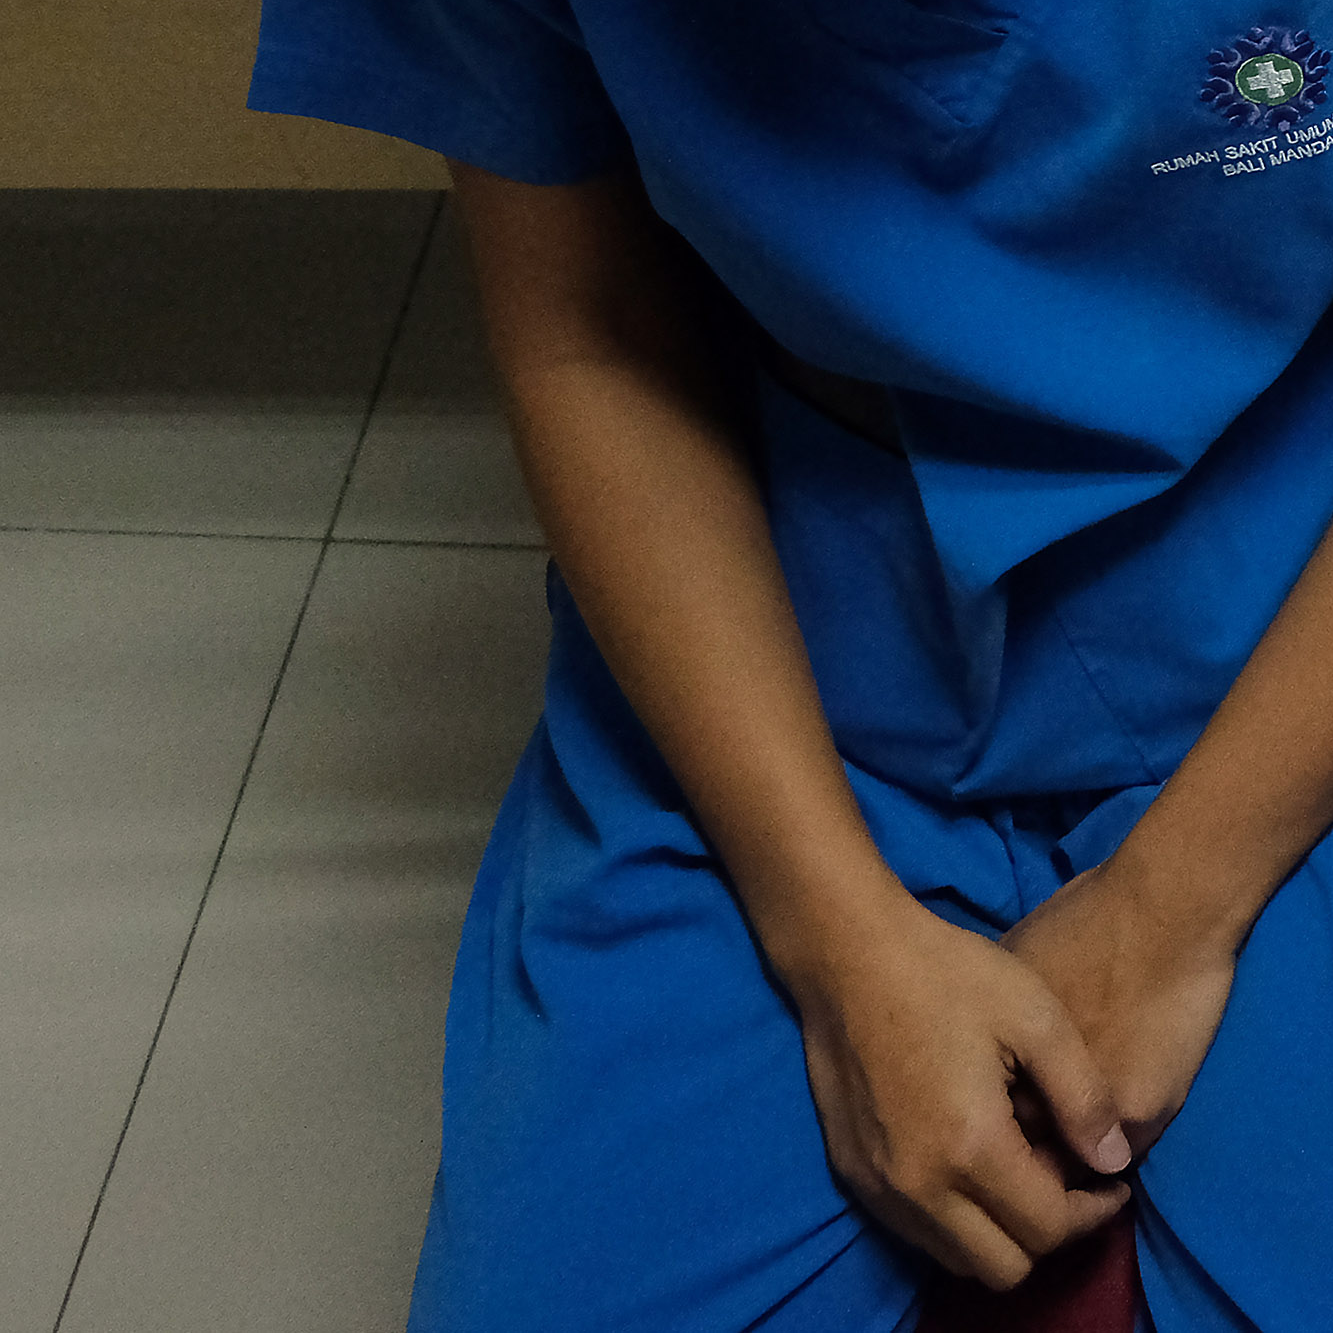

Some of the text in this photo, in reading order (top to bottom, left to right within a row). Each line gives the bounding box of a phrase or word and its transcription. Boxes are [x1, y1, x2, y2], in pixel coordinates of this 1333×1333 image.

[1150, 150, 1219, 175] RUMAH
[1224, 136, 1277, 160] SAKIT
[1223, 157, 1265, 177] BALI
